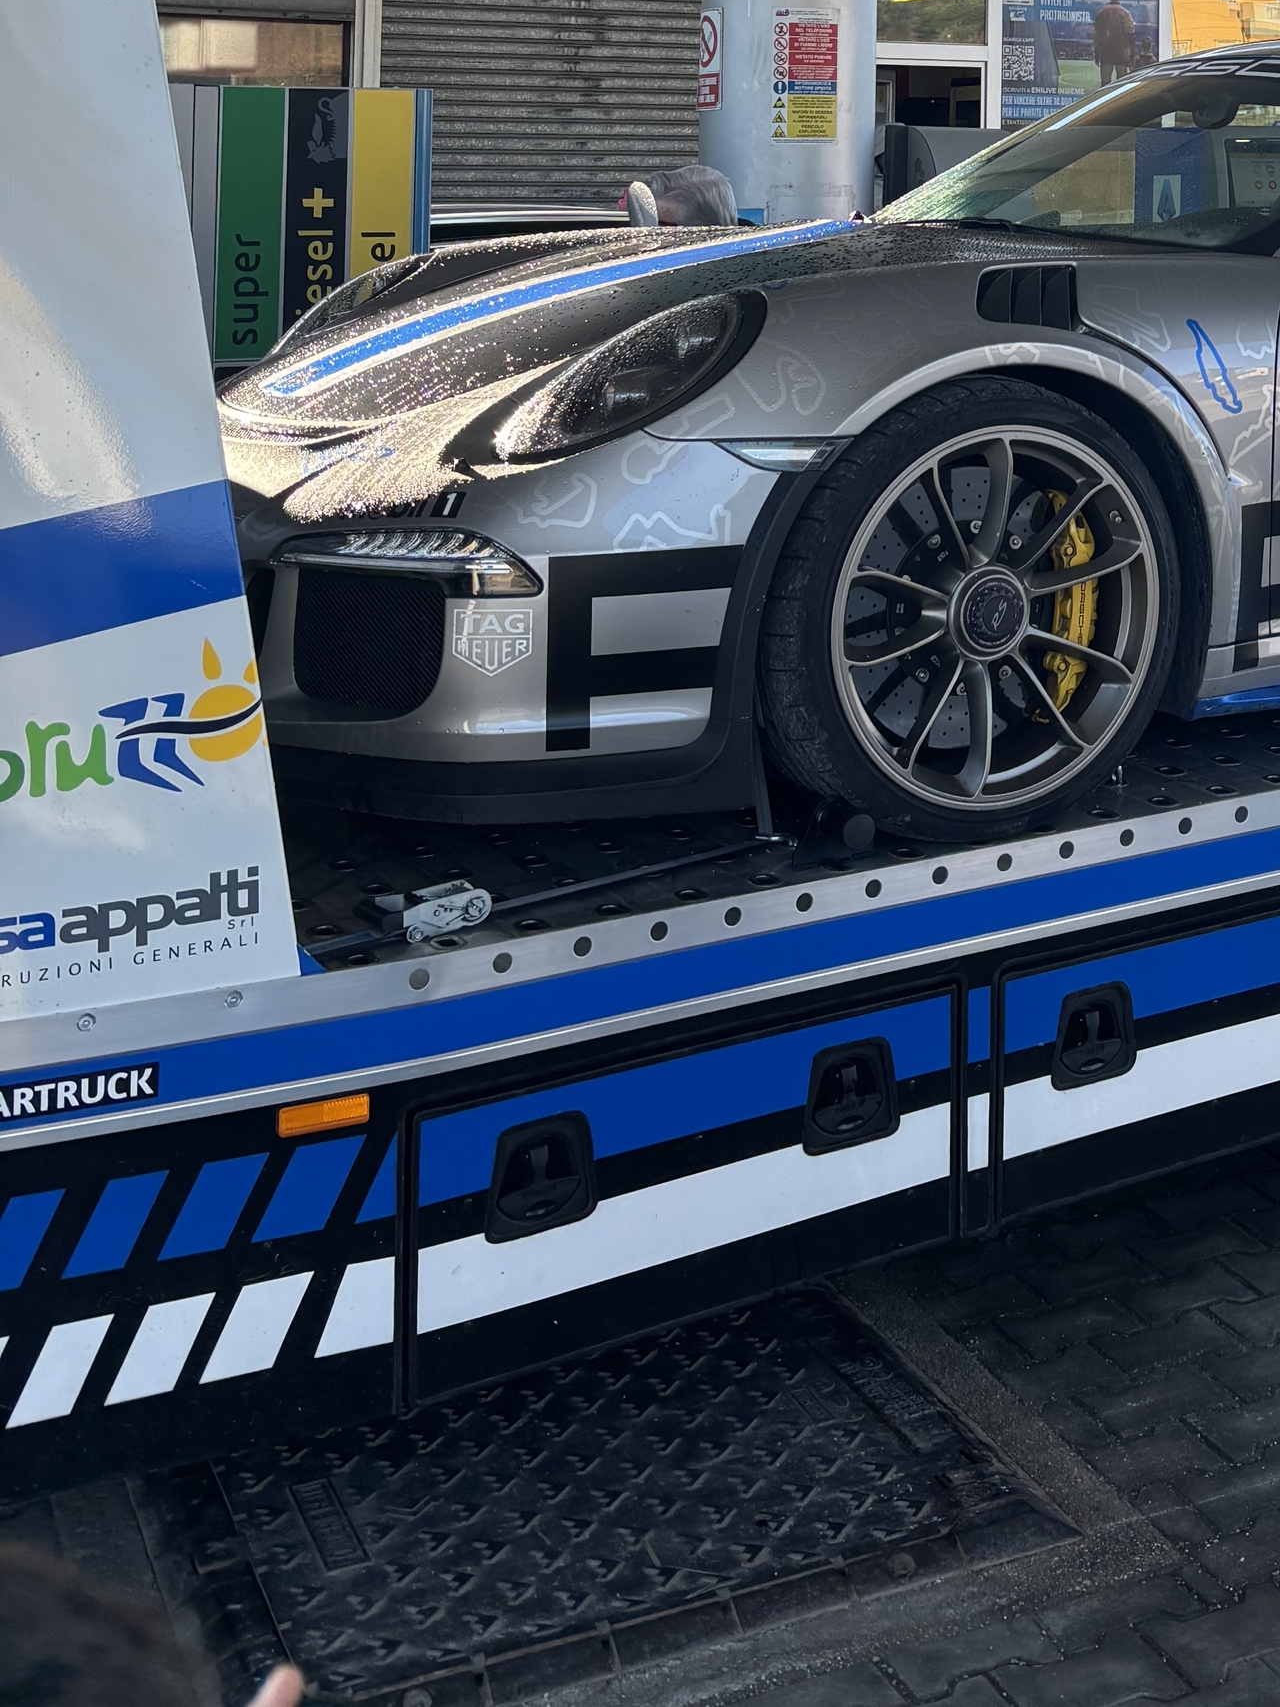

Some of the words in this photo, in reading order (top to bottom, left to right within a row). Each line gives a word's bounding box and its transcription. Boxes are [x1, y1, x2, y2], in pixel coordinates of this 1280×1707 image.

[1002, 95, 1013, 105] PER
[231, 233, 270, 346] super
[296, 230, 334, 315] esel
[460, 613, 525, 634] TAG
[457, 638, 527, 672] HEUER
[227, 915, 255, 931] Srl
[133, 931, 260, 966] GENERALI
